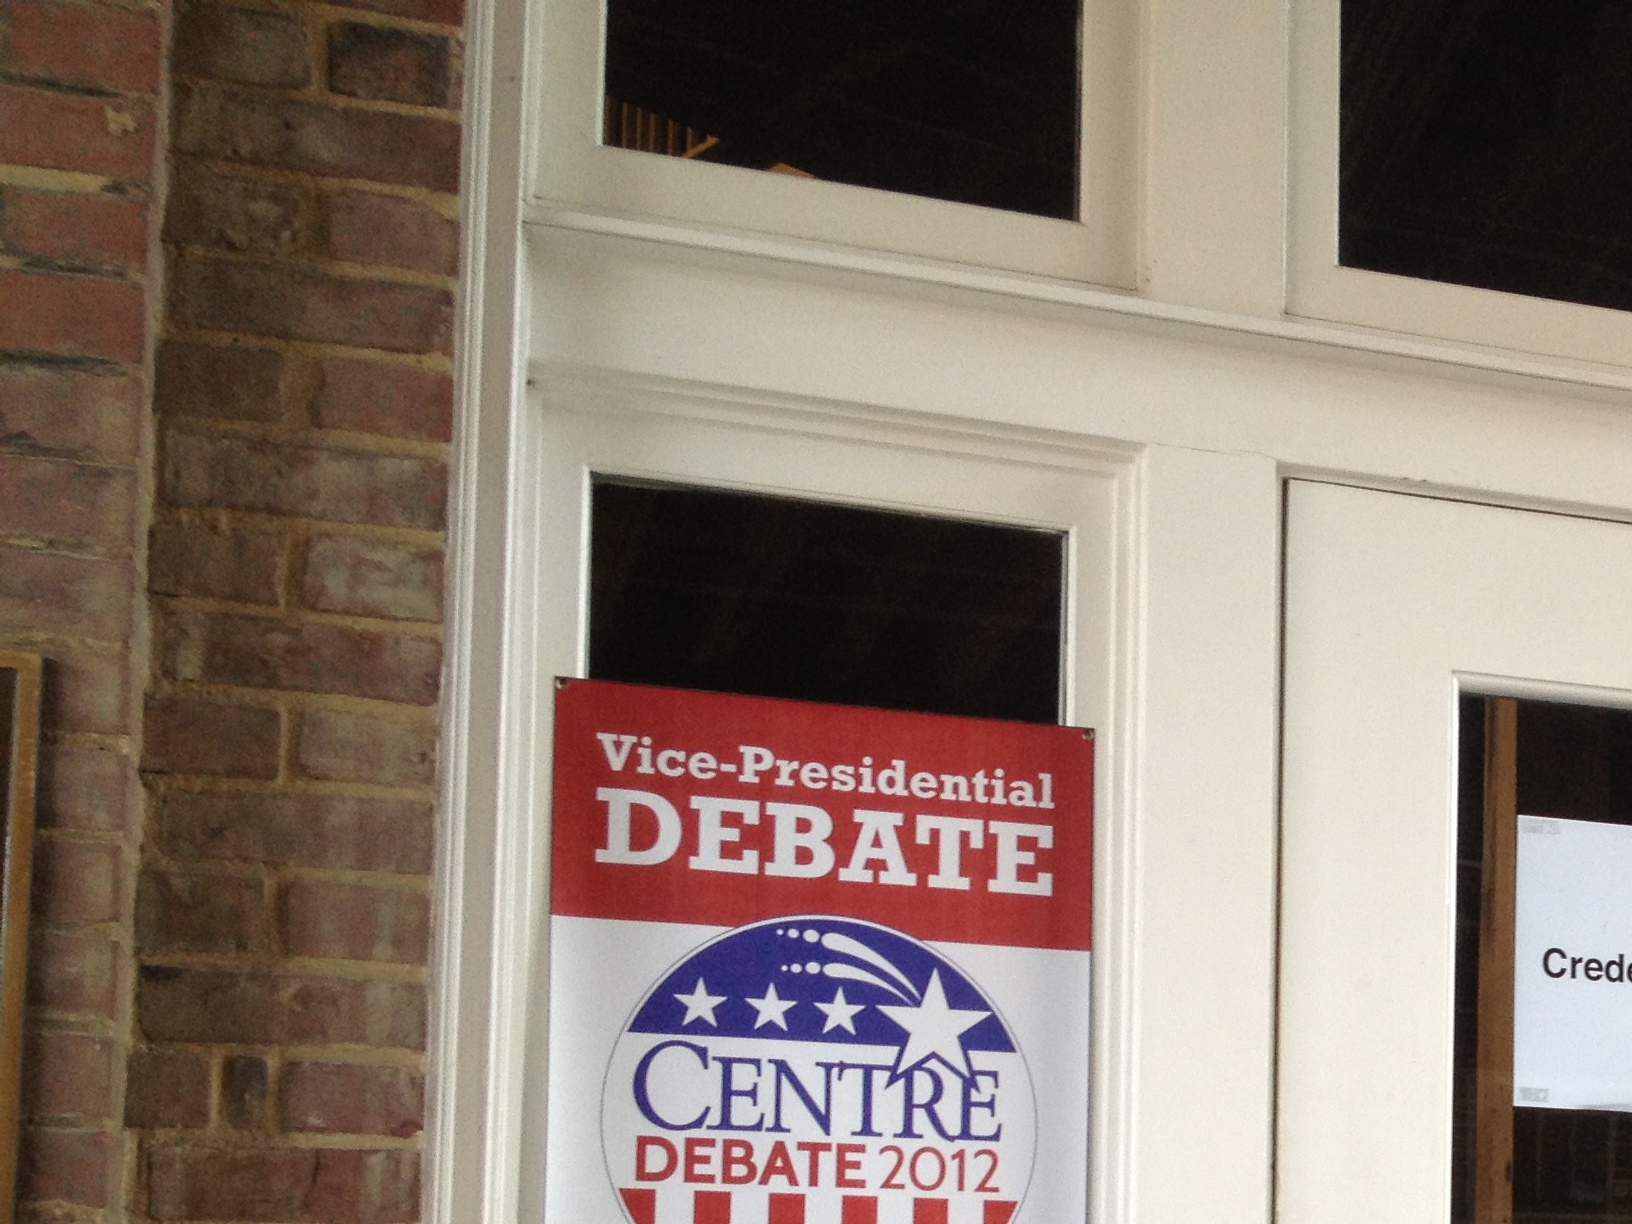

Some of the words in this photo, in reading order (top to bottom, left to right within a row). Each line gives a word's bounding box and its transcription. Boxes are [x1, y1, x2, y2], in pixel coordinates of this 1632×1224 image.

[596, 731, 1056, 809] Vice-Presidential
[595, 786, 1054, 897] DEBATE
[632, 1040, 1003, 1143] CENTRE
[634, 1135, 867, 1190] DEBATE
[878, 1145, 1000, 1193] 2012
